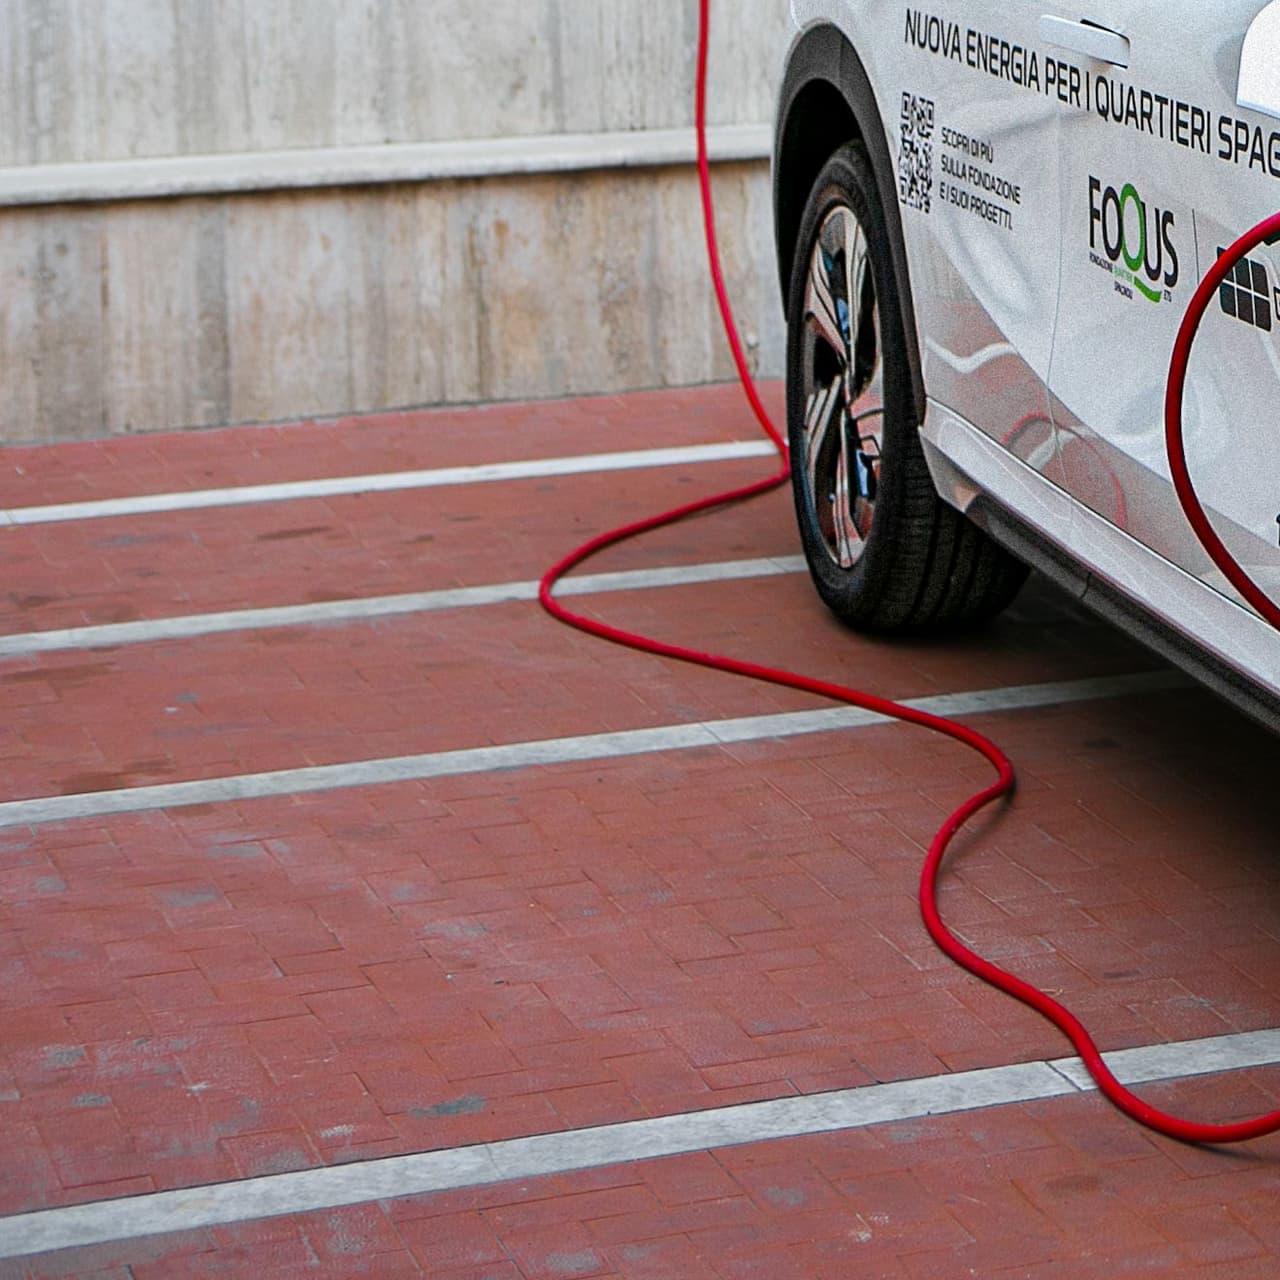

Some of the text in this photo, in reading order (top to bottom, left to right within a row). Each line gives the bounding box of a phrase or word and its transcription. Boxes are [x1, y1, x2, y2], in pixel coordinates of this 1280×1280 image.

[905, 8, 961, 62] NUOVA
[966, 29, 1040, 92] ENERGIA
[1046, 57, 1081, 107] PER
[1086, 71, 1091, 111] I
[1095, 75, 1211, 155] QUARTIERI
[941, 127, 970, 156] SCOPRI
[971, 139, 980, 159] DI
[940, 181, 946, 200] E
[950, 186, 969, 211] SUOI
[941, 154, 1021, 205] SULLA FONDAZIONE
